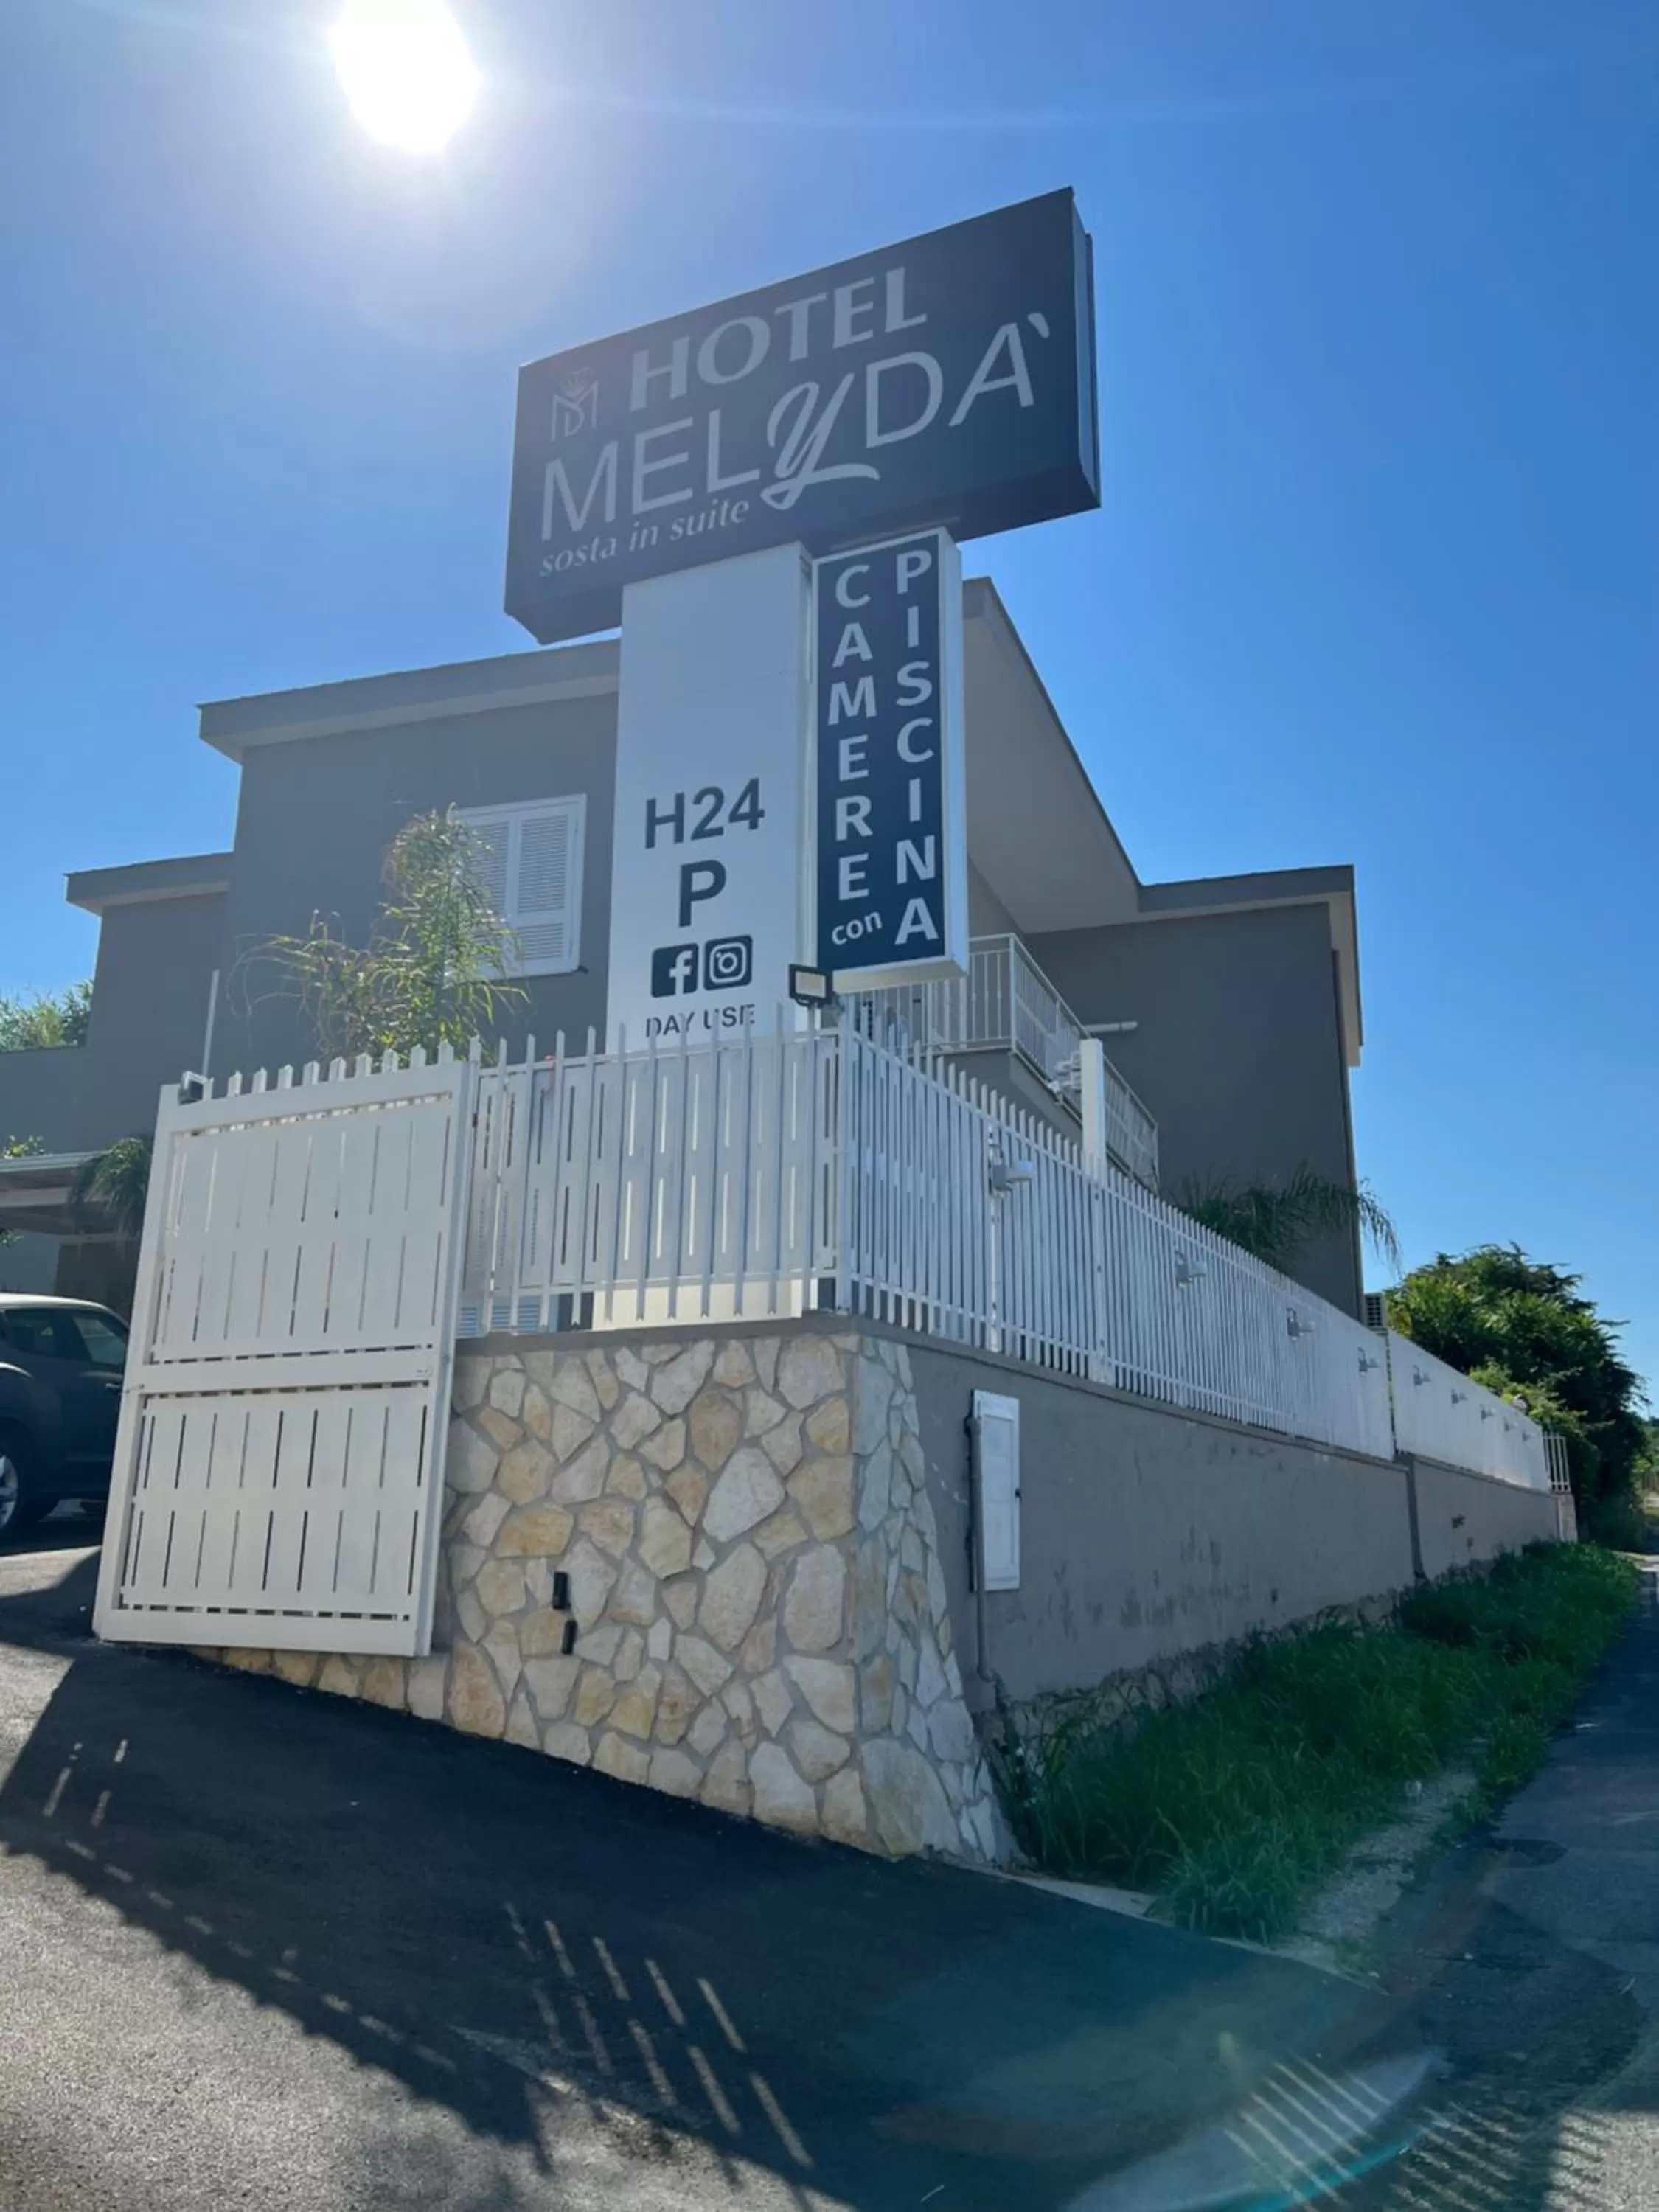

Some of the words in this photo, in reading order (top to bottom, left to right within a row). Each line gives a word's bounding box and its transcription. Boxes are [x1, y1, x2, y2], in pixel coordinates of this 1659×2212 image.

[629, 266, 927, 411] HOTEL
[539, 536, 616, 577] sosta
[629, 520, 658, 552] in
[669, 498, 750, 541] suite
[827, 564, 877, 901] CAMERE
[895, 549, 939, 945] PISCINA
[644, 777, 765, 849] H24
[678, 859, 727, 928] P
[831, 909, 883, 946] con
[646, 1011, 695, 1037] DAY
